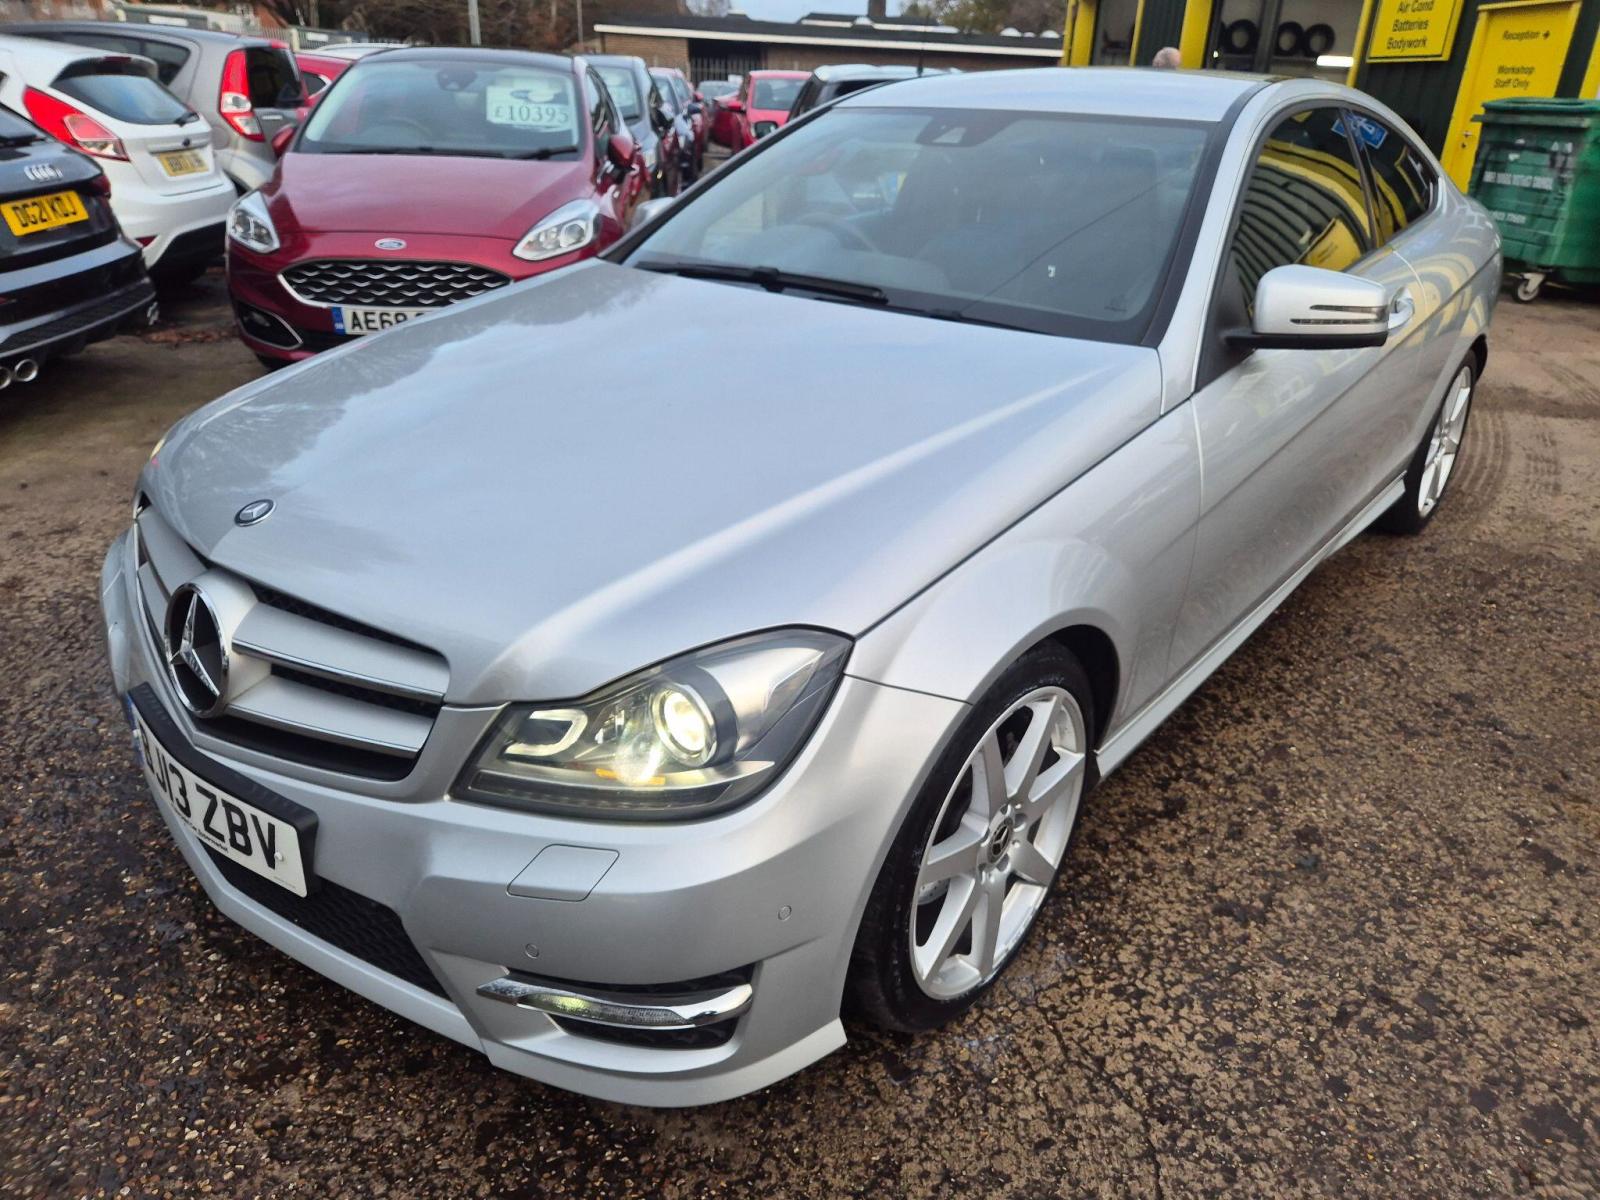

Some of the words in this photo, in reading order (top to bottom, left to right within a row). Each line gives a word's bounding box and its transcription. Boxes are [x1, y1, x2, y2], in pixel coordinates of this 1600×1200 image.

[1392, 19, 1429, 32] Batteries
[1503, 30, 1540, 41] Reception
[1386, 36, 1428, 52] Bodywork
[495, 105, 569, 123] £10395
[196, 786, 275, 869] ZBV
